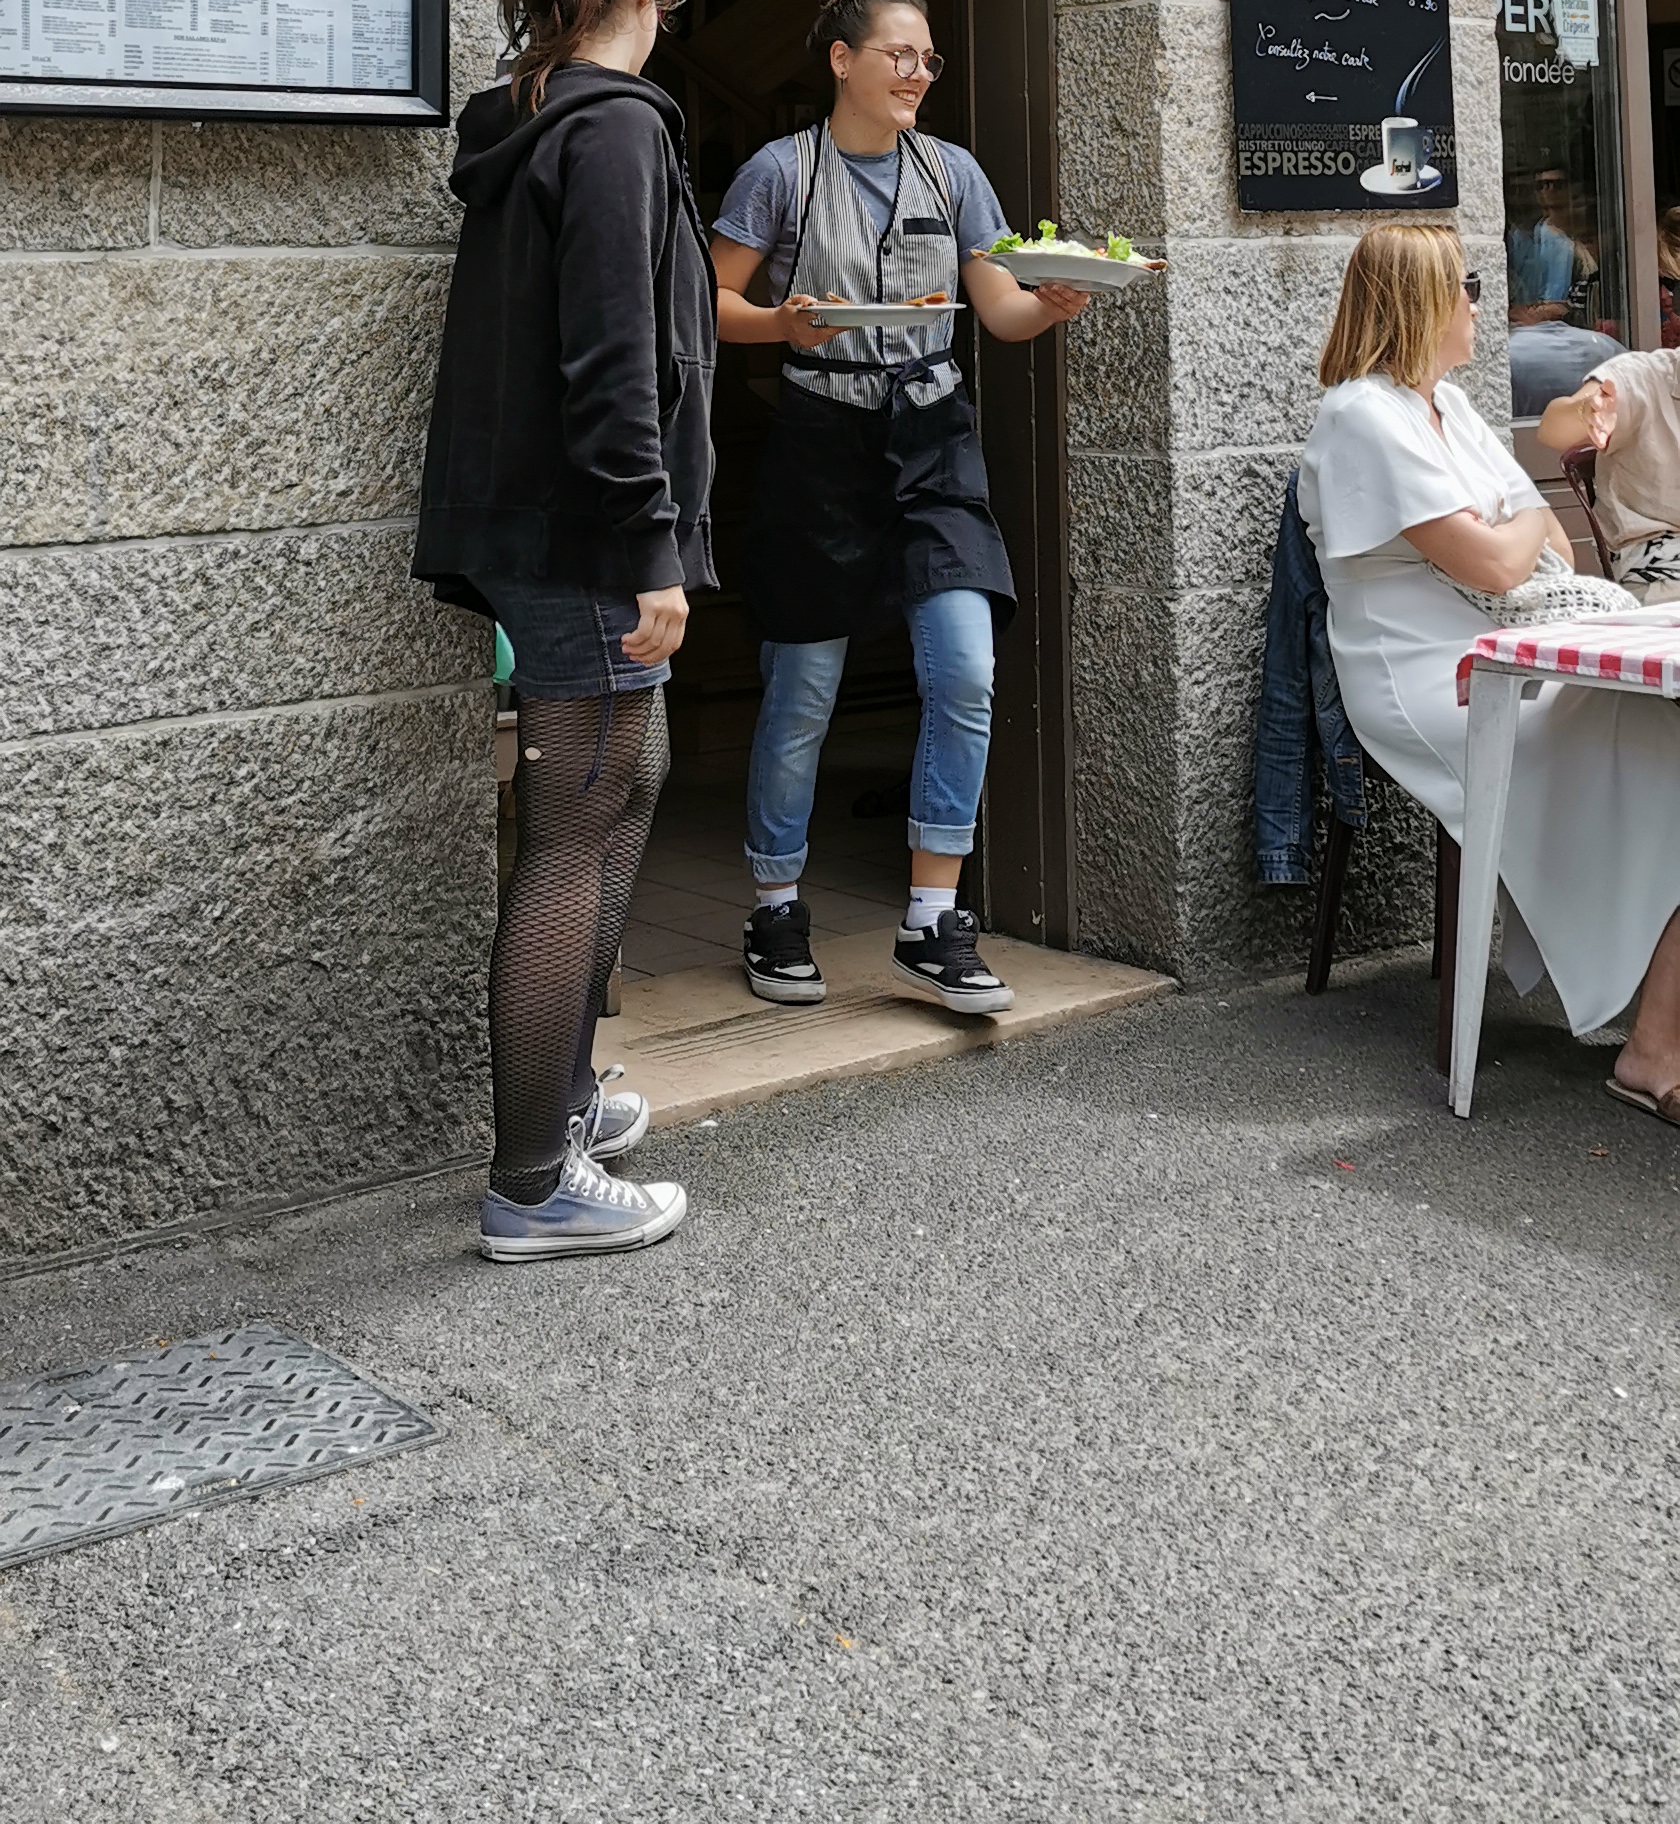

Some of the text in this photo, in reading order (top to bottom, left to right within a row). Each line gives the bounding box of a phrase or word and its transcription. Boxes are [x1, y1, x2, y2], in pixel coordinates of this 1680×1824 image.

[1255, 23, 1374, 71] Consultez notre carte
[1502, 55, 1575, 84] fondée
[1238, 140, 1292, 151] RISTRETTO
[1292, 140, 1325, 151] LUNGO
[1239, 151, 1356, 176] ESPRESSO
